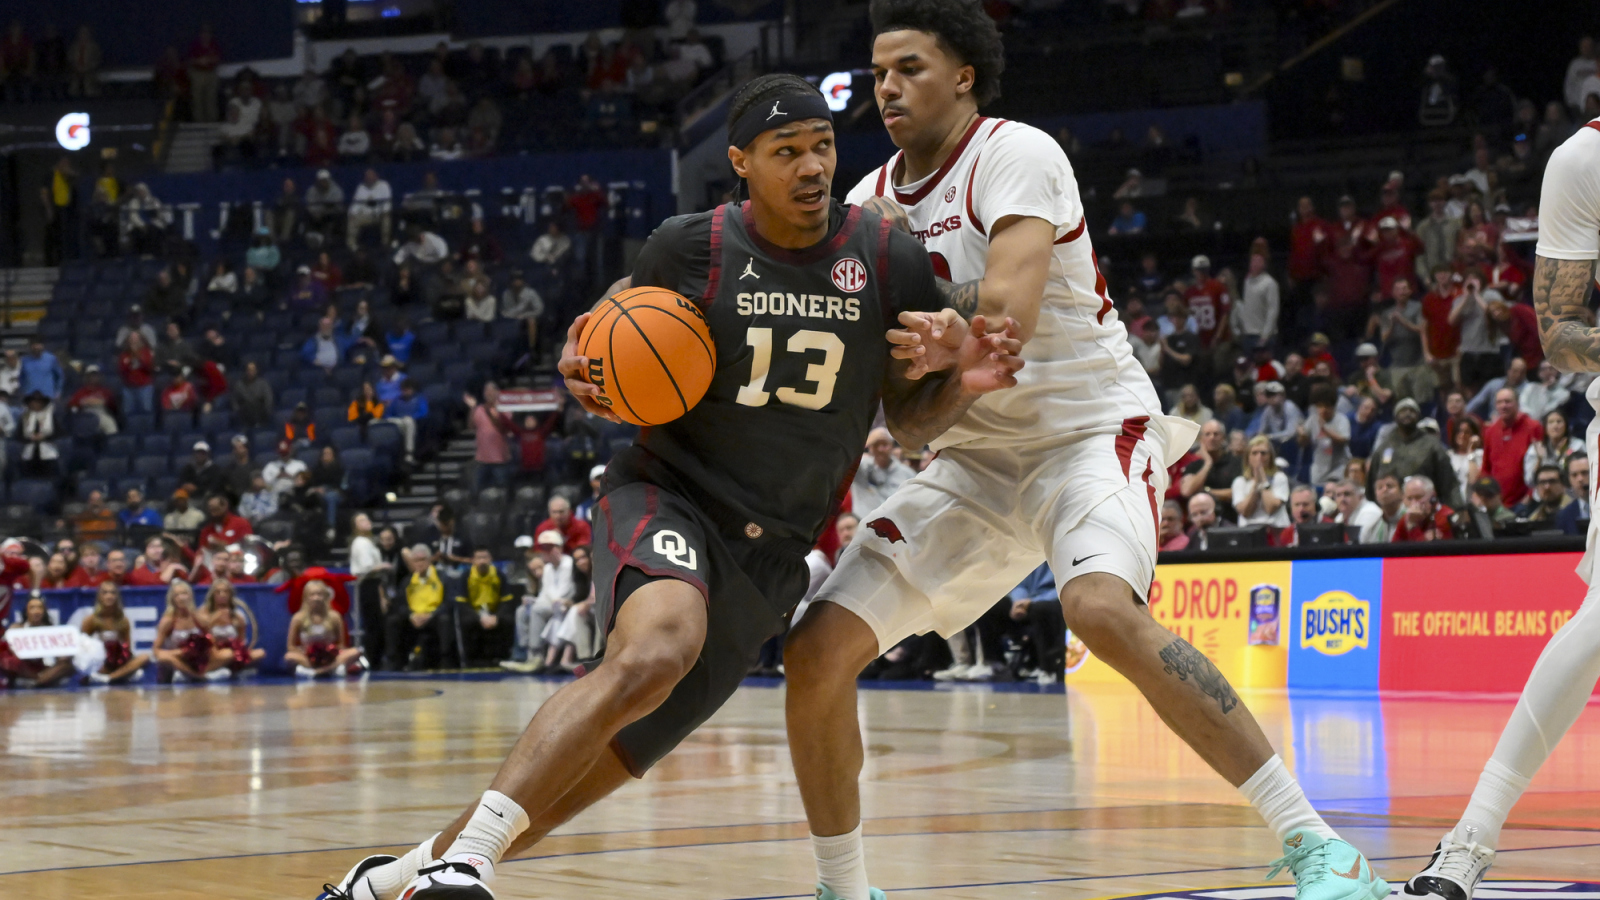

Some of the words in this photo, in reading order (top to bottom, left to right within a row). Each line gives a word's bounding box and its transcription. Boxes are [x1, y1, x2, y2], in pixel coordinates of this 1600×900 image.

[819, 72, 852, 111] G
[55, 112, 90, 151] G
[834, 261, 864, 289] SEC
[737, 292, 860, 321] SOONERS
[736, 327, 845, 410] 13
[653, 530, 697, 570] OU
[1173, 579, 1240, 619] DROP.
[1305, 608, 1364, 639] BUSH'S
[1393, 611, 1425, 636] THE
[1428, 611, 1494, 636] OFFICIAL
[1495, 610, 1547, 636] BEANS
[13, 632, 76, 651] DEFENSE
